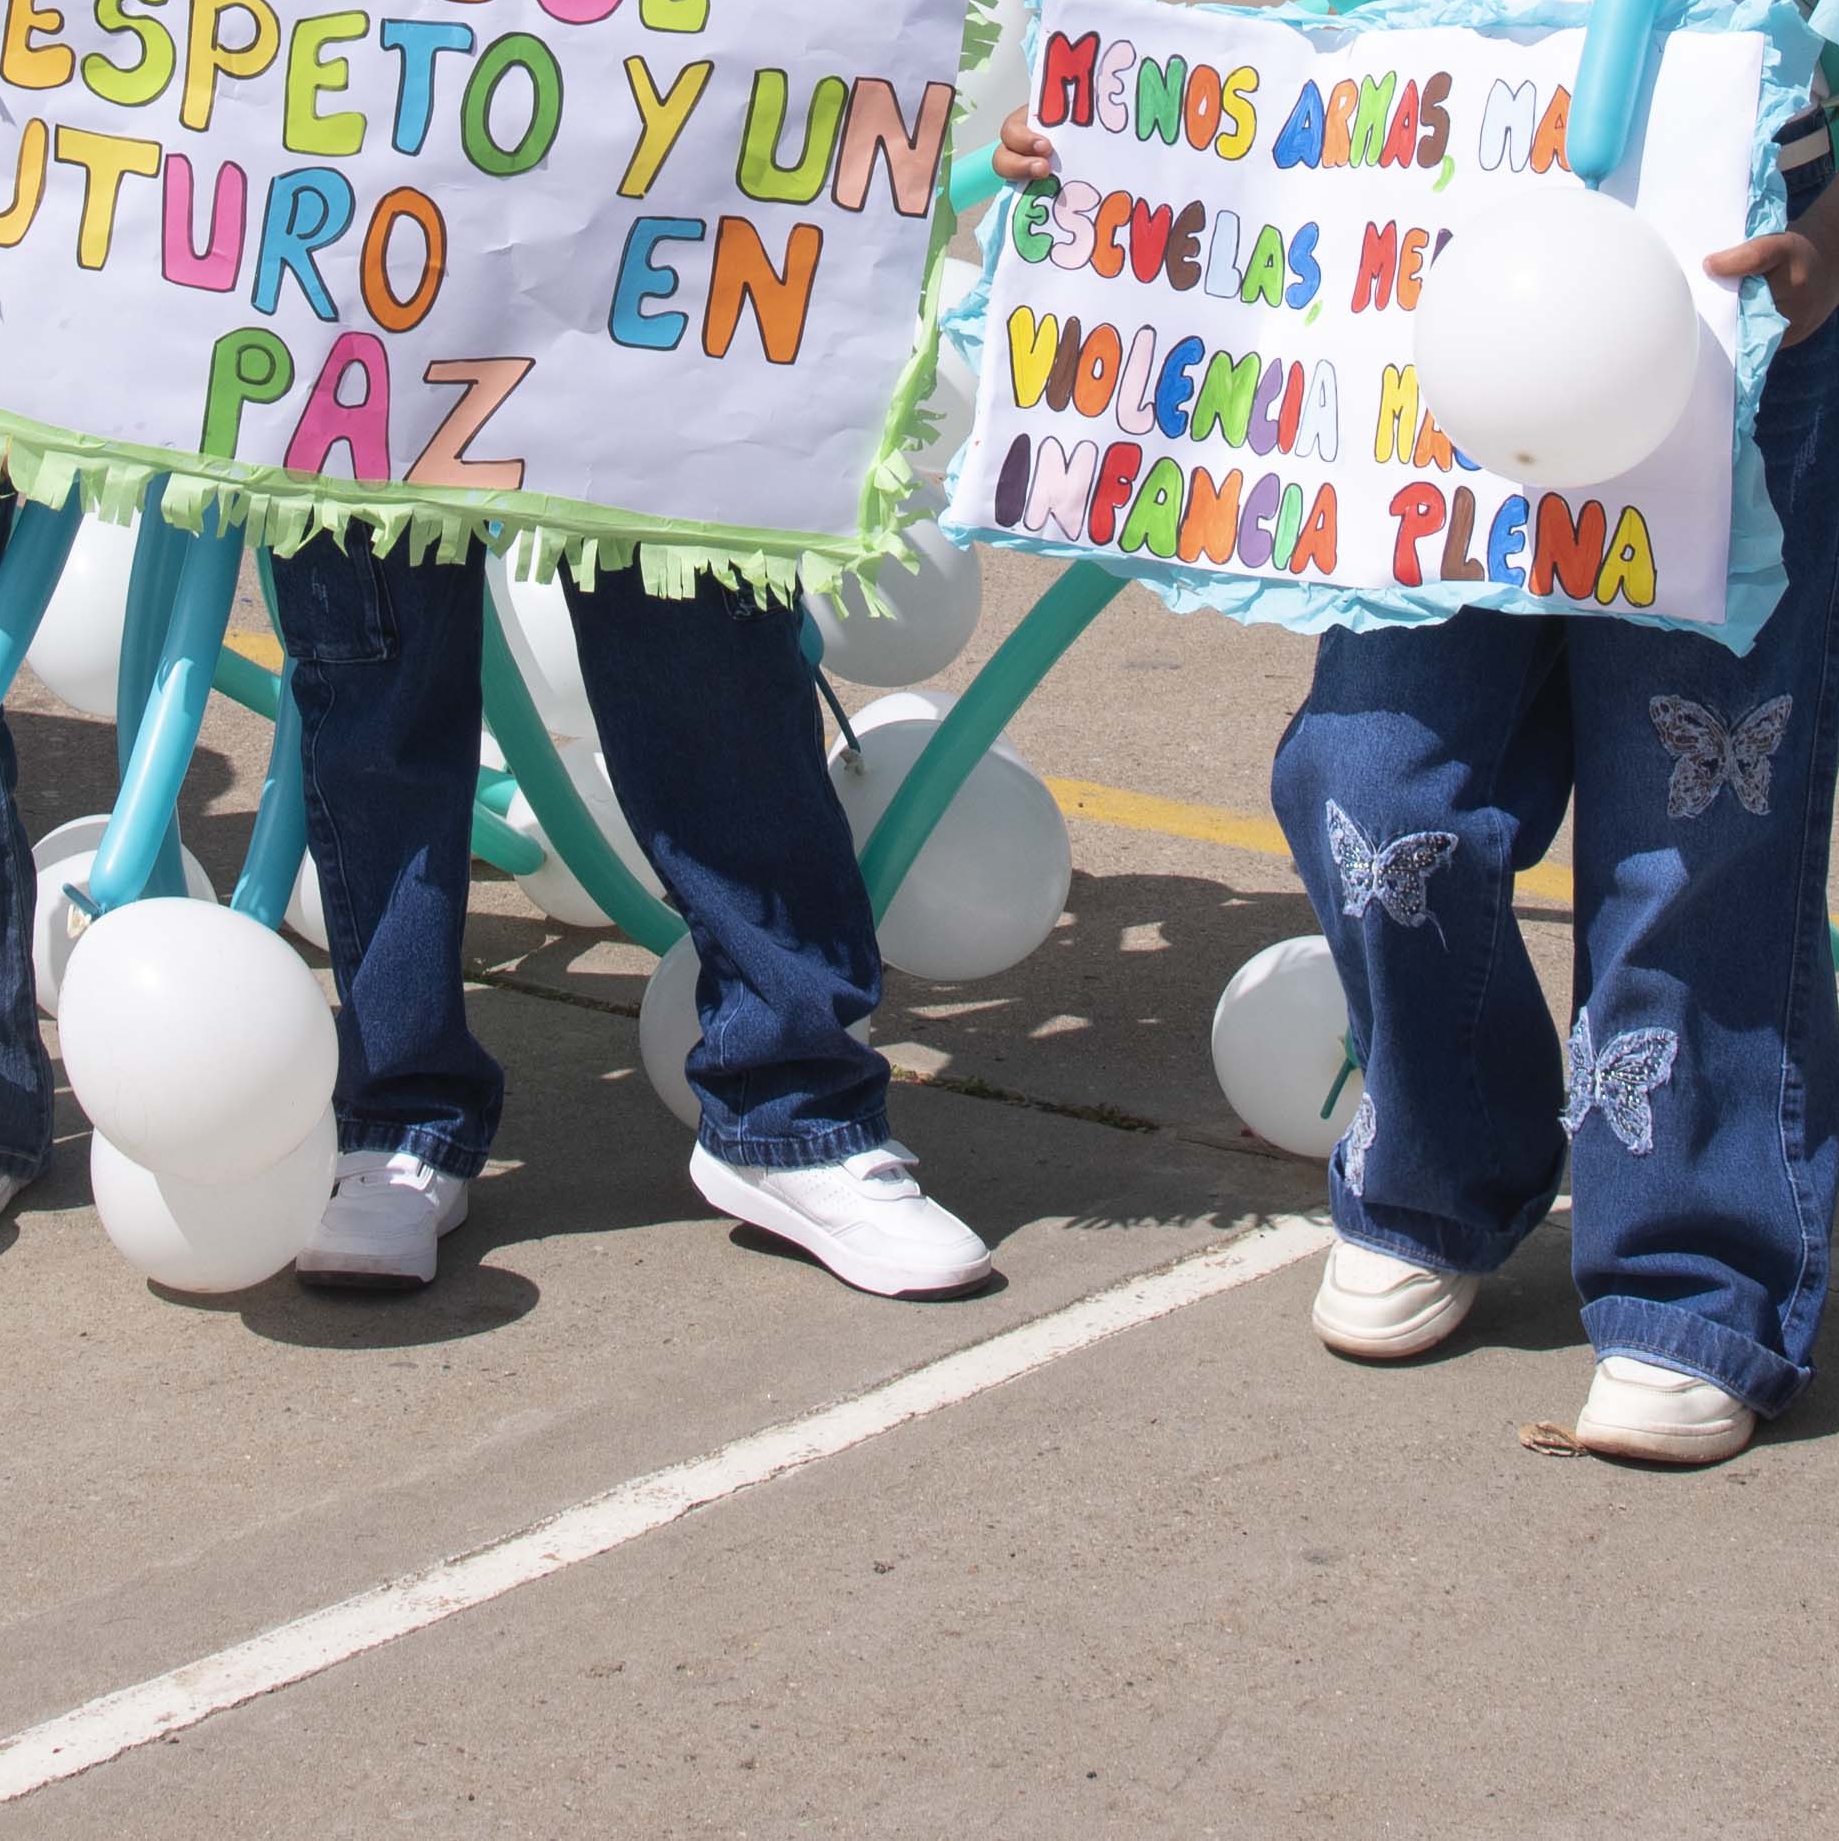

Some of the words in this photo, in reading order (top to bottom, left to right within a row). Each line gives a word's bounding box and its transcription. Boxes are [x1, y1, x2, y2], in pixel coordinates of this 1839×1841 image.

[616, 54, 715, 199] Y
[735, 67, 957, 219] UN
[1037, 30, 1259, 161] MENOS
[1272, 70, 1456, 192] ARMAS,
[1478, 78, 1572, 174] MA
[608, 214, 825, 365] EN
[1351, 219, 1454, 313] ME
[199, 326, 536, 491] PAZ
[1008, 305, 1340, 463] VIOLENCIA
[1374, 362, 1482, 473] MA
[993, 432, 1338, 577] INFANCIA
[1388, 480, 1657, 609] PLENA
